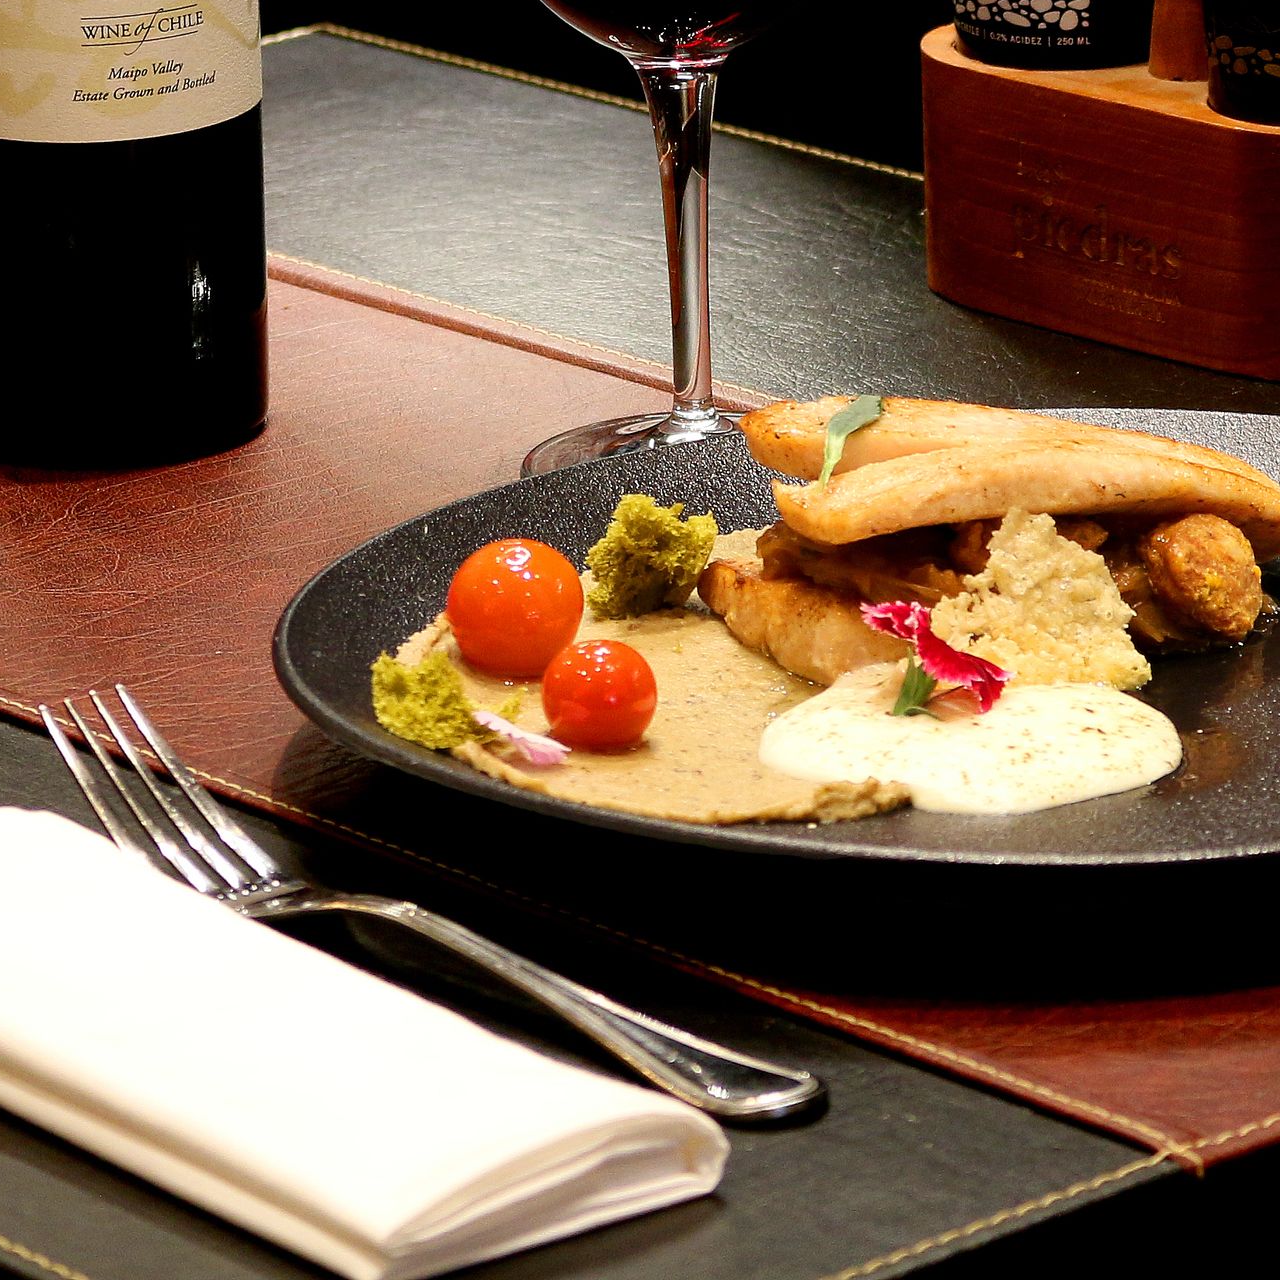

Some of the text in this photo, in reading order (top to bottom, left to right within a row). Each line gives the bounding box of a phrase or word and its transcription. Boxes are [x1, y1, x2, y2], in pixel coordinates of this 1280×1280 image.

[80, 7, 204, 56] WINE of CHILE
[1009, 35, 1043, 46] ACIDEZ
[1056, 36, 1075, 47] 250
[1076, 36, 1091, 46] ML
[107, 59, 184, 82] Maipo Valley
[72, 70, 217, 103] Estate Grown and Bottled
